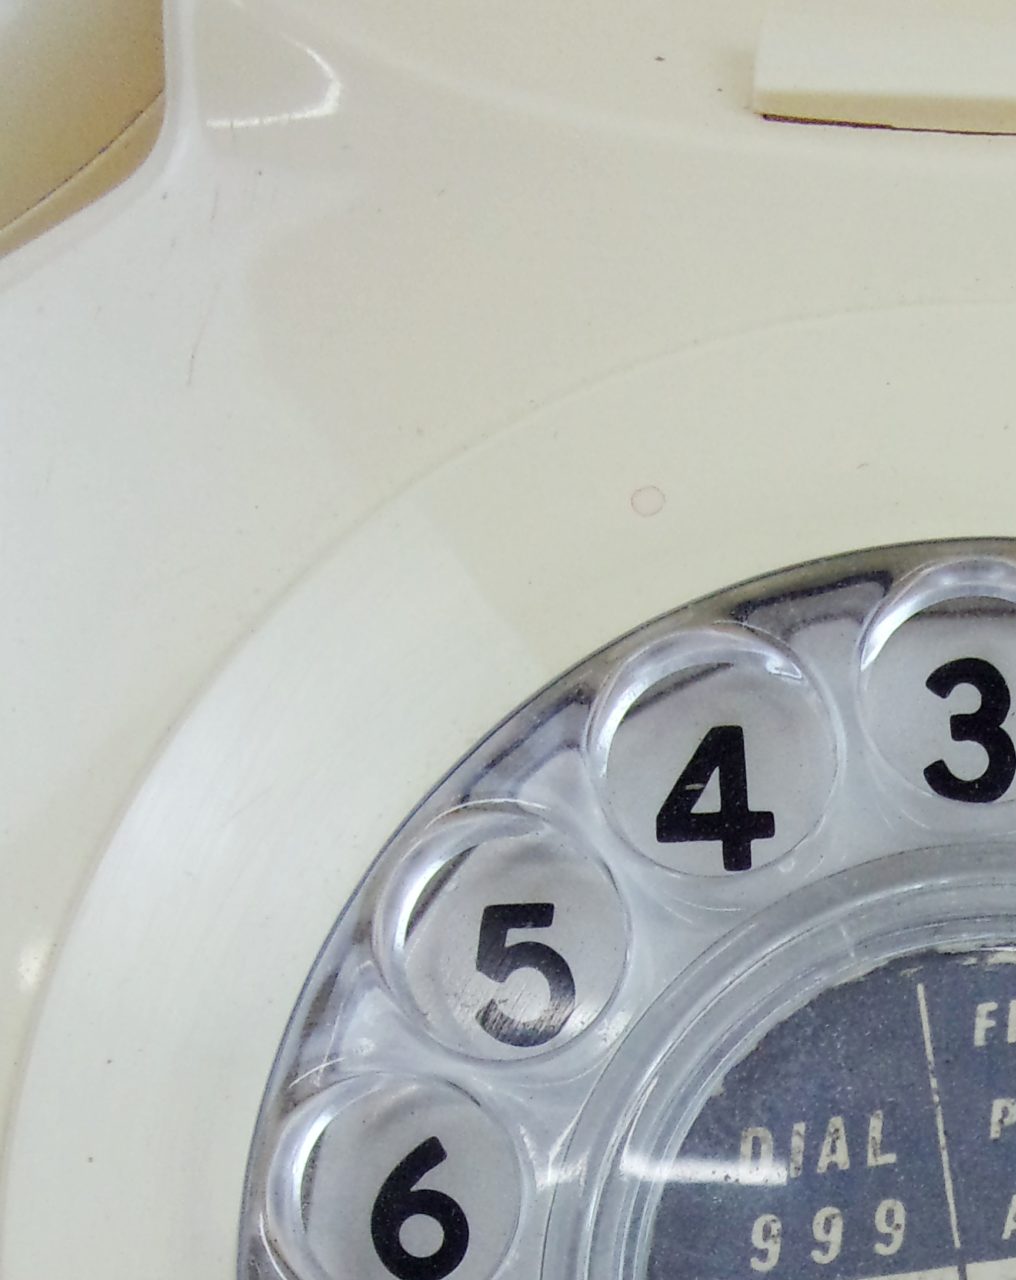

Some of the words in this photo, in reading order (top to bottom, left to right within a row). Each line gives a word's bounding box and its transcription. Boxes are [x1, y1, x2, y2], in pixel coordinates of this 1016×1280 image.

[656, 725, 775, 871] 4
[924, 658, 1016, 803] 3
[474, 900, 577, 1048] 5
[738, 1112, 898, 1187] DIAL
